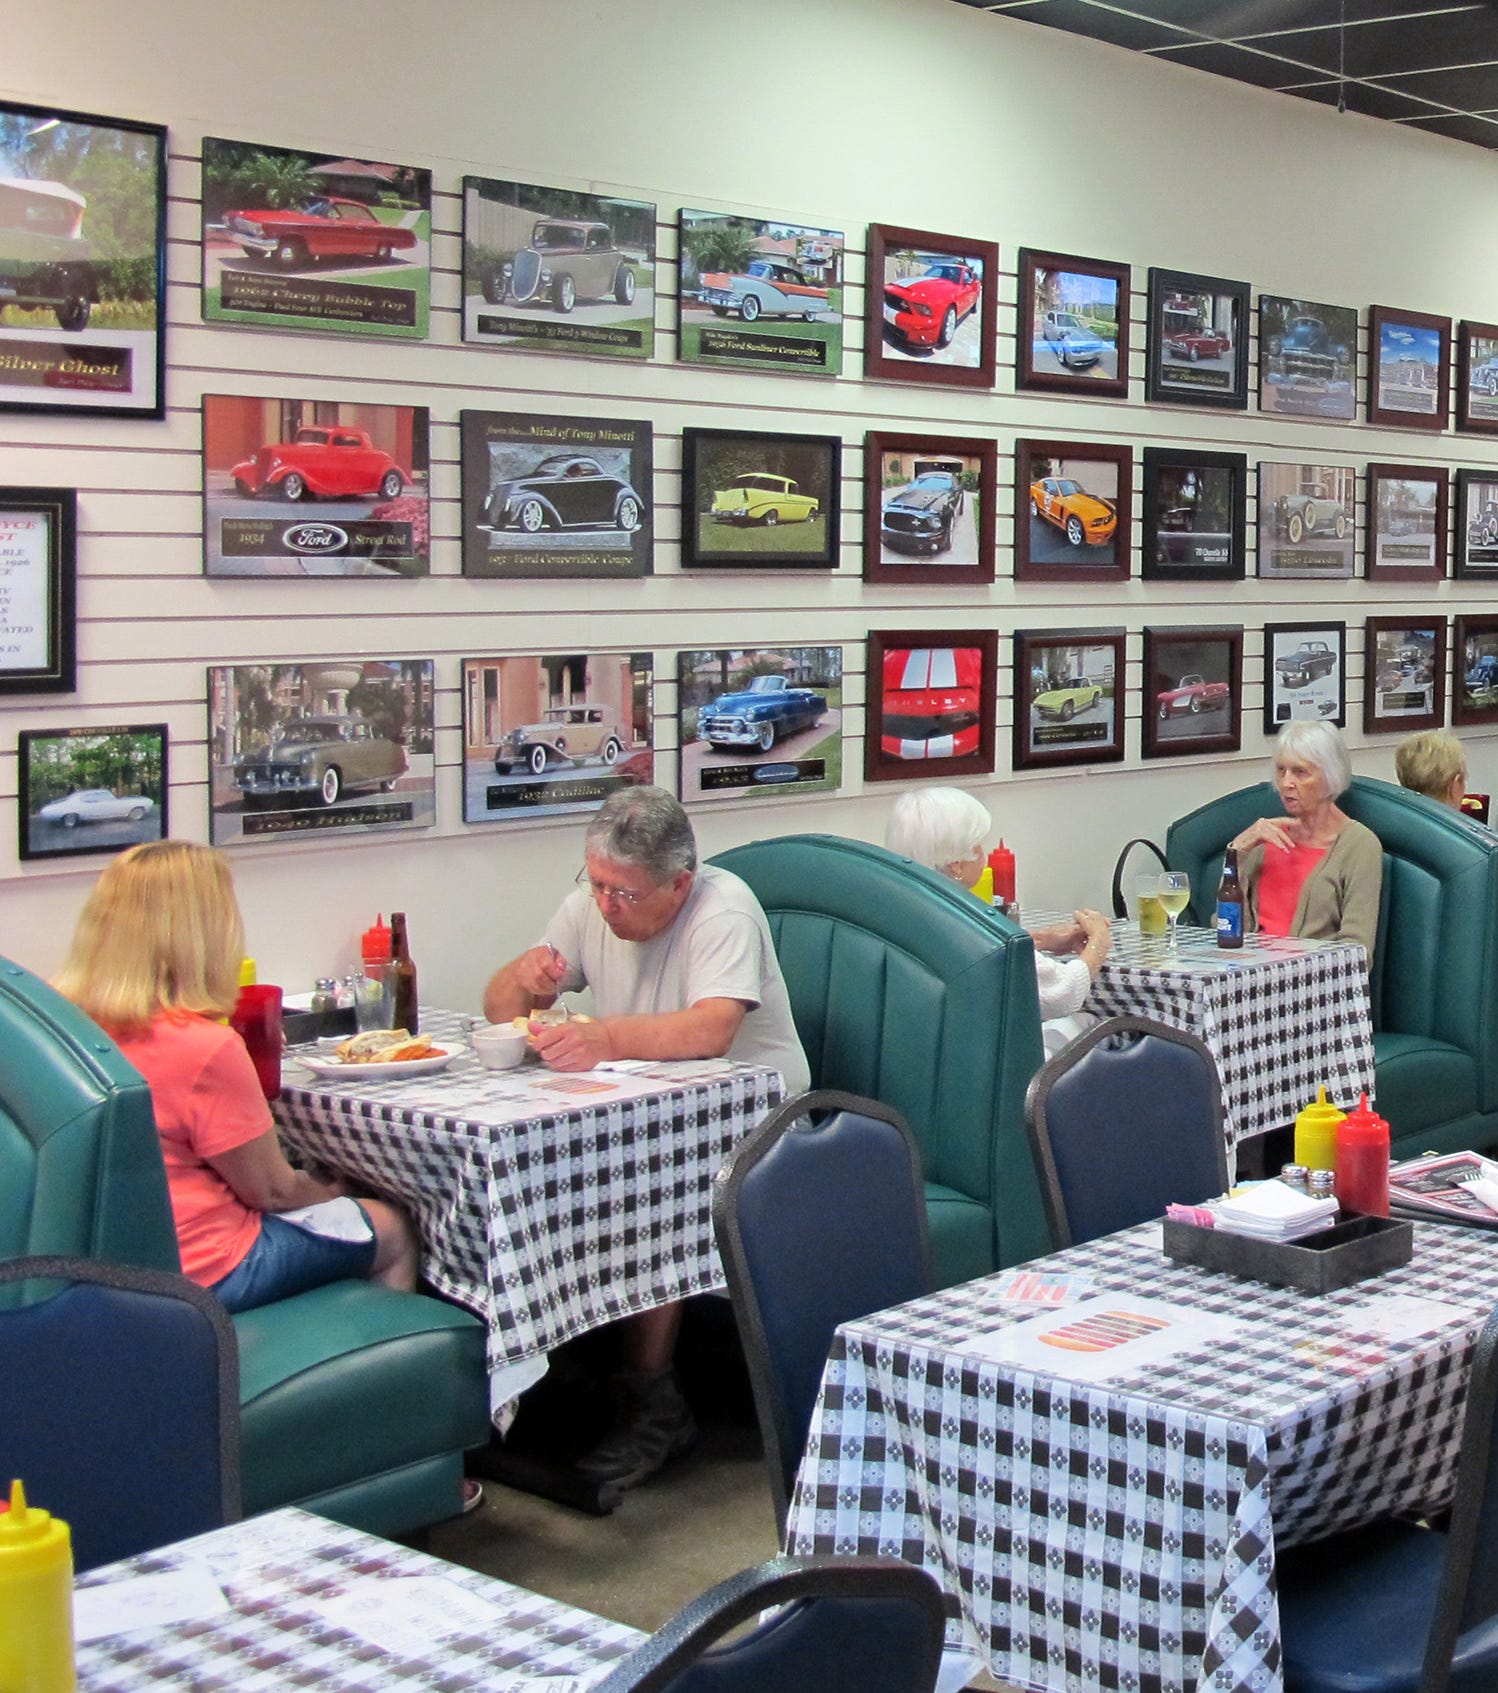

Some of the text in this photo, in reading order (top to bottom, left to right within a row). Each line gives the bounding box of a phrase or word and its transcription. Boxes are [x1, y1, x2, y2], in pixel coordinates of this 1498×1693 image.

[0, 354, 120, 376] ilver Ghost
[297, 527, 333, 547] Ford
[354, 534, 384, 545] Street
